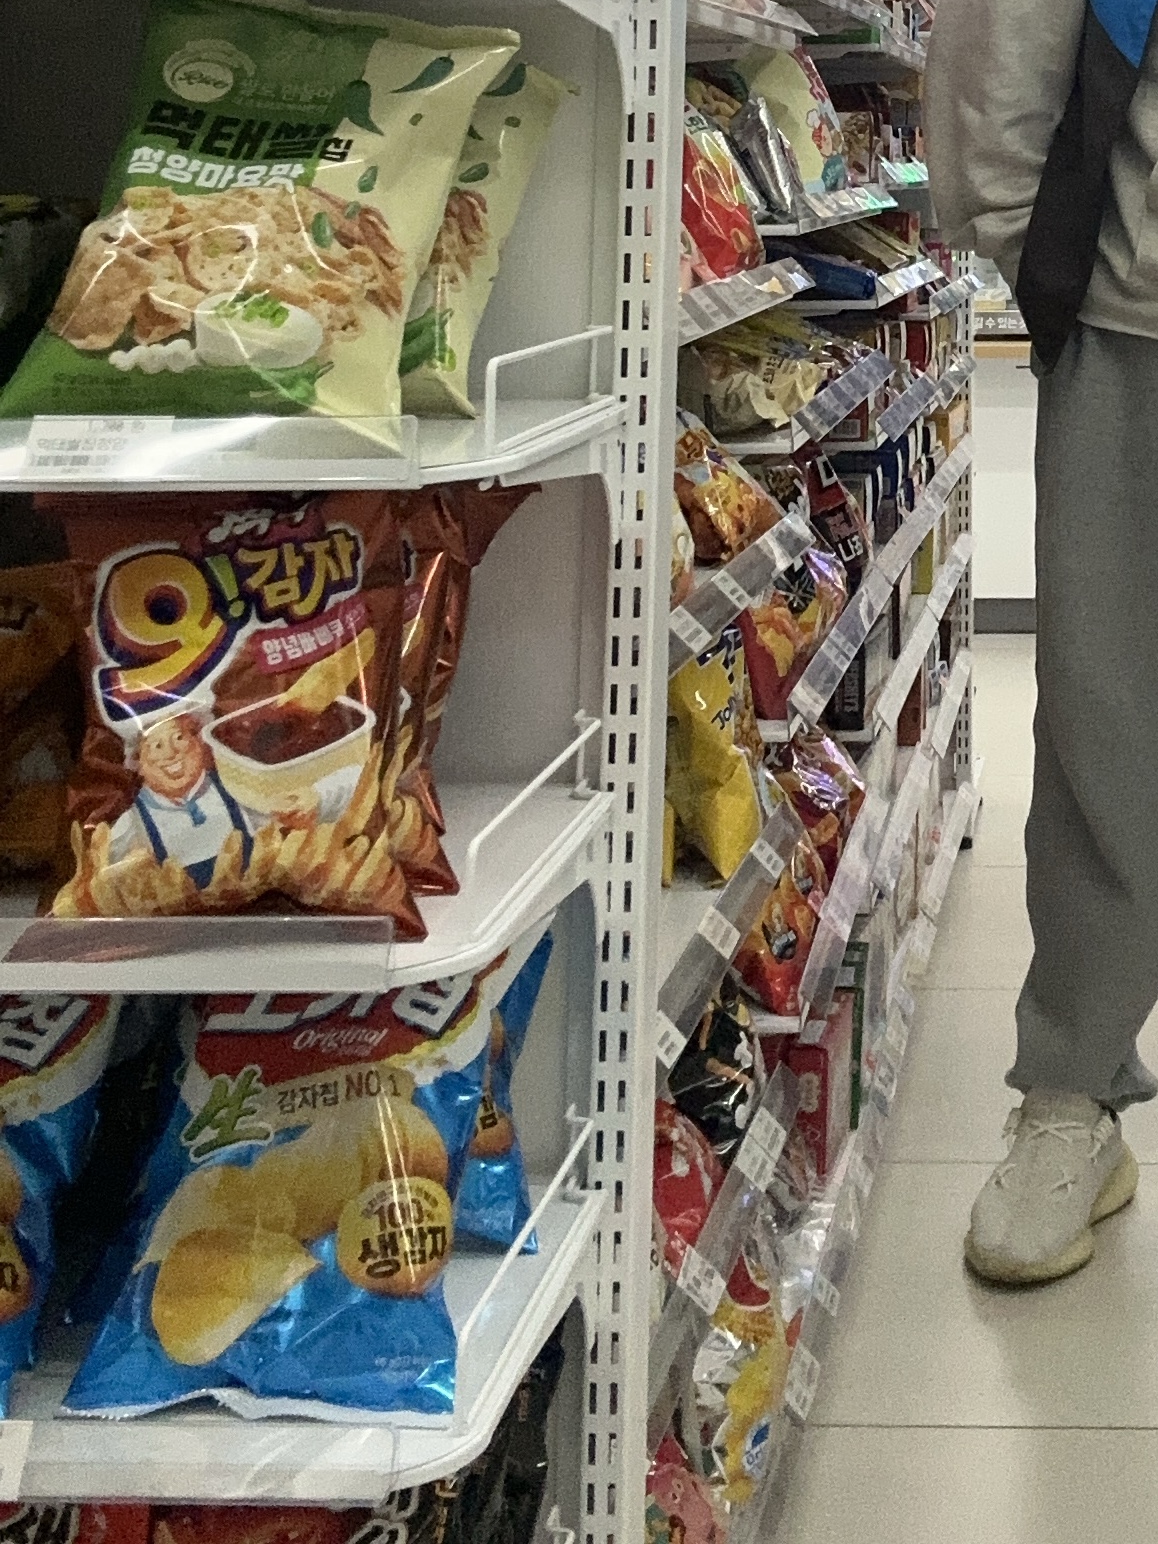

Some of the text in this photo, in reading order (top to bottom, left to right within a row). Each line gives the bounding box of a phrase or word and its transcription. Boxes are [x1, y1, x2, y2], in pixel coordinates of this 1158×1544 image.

[127, 145, 305, 194] 청양마요맛
[292, 1027, 389, 1051] Original
[276, 1081, 340, 1116] 감자칩
